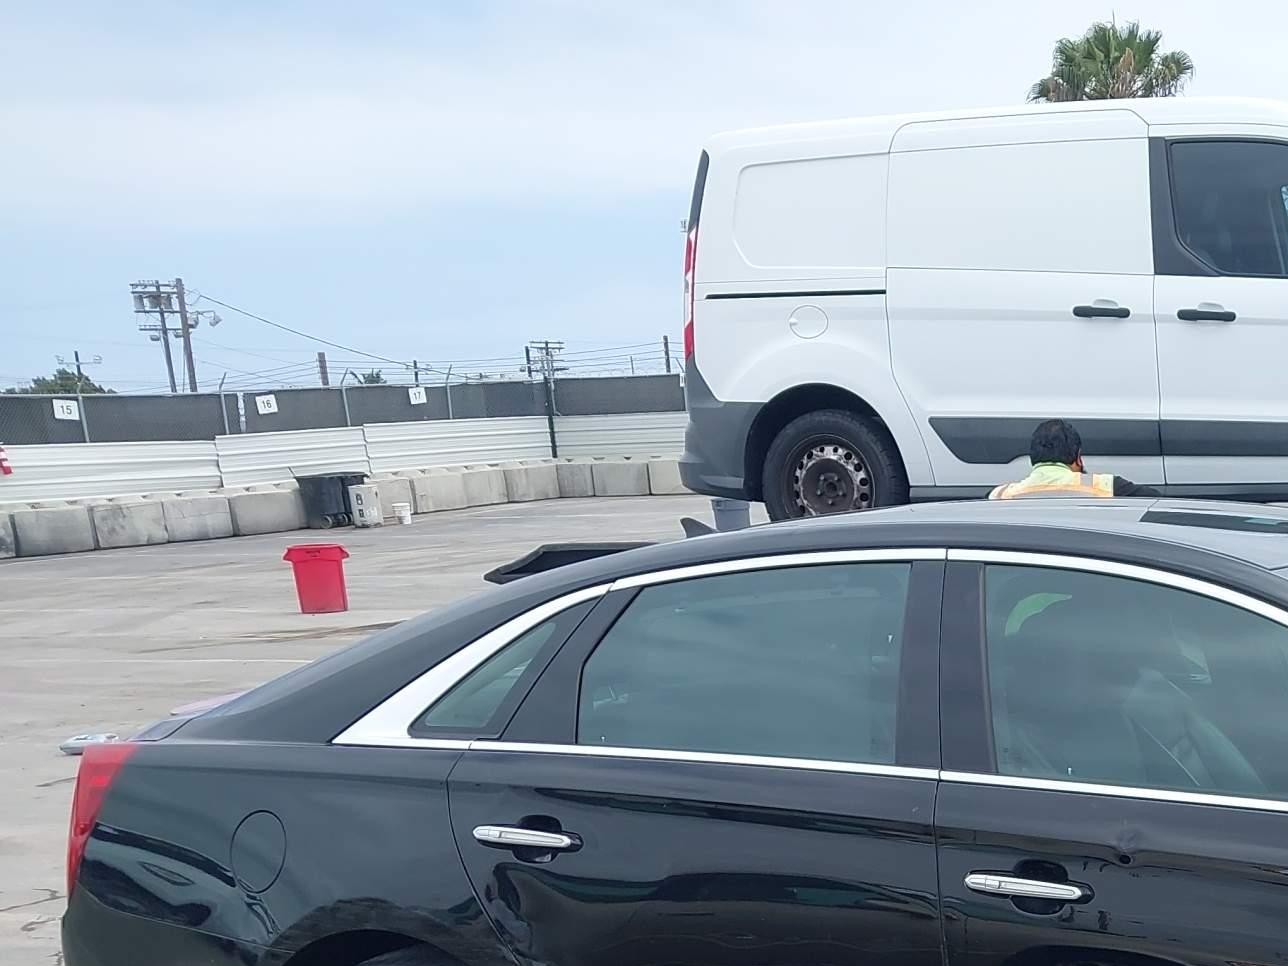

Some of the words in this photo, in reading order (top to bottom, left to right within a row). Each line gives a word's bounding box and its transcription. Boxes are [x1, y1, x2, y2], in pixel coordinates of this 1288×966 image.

[413, 391, 421, 400] 17
[262, 399, 272, 409] 16
[60, 404, 72, 415] 15
